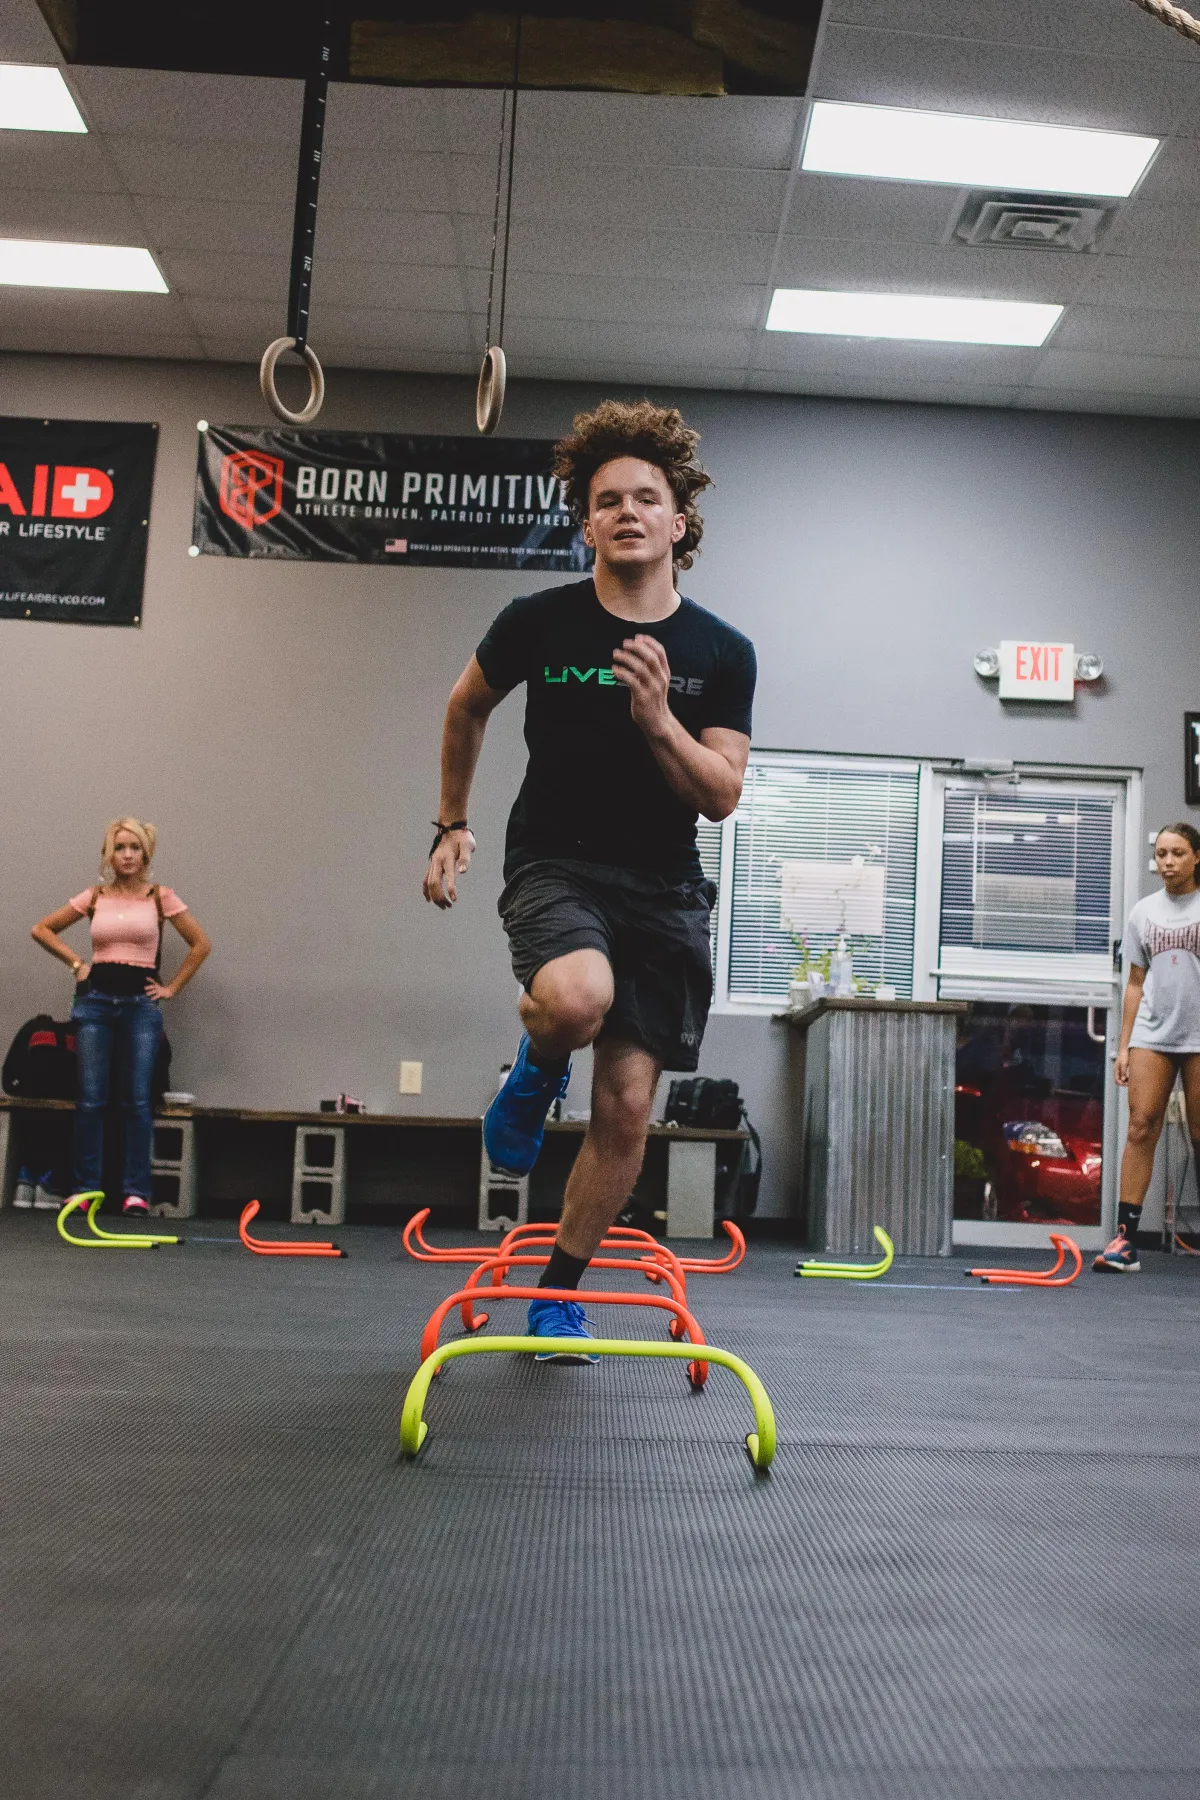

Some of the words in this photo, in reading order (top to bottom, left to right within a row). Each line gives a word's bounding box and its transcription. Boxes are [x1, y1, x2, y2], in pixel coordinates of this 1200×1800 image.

[296, 466, 388, 503] BORN
[295, 503, 356, 518] ATHLETE
[431, 509, 492, 523] PATRIOT
[19, 523, 106, 541] LIFESTYLE
[1016, 646, 1064, 682] EXIT
